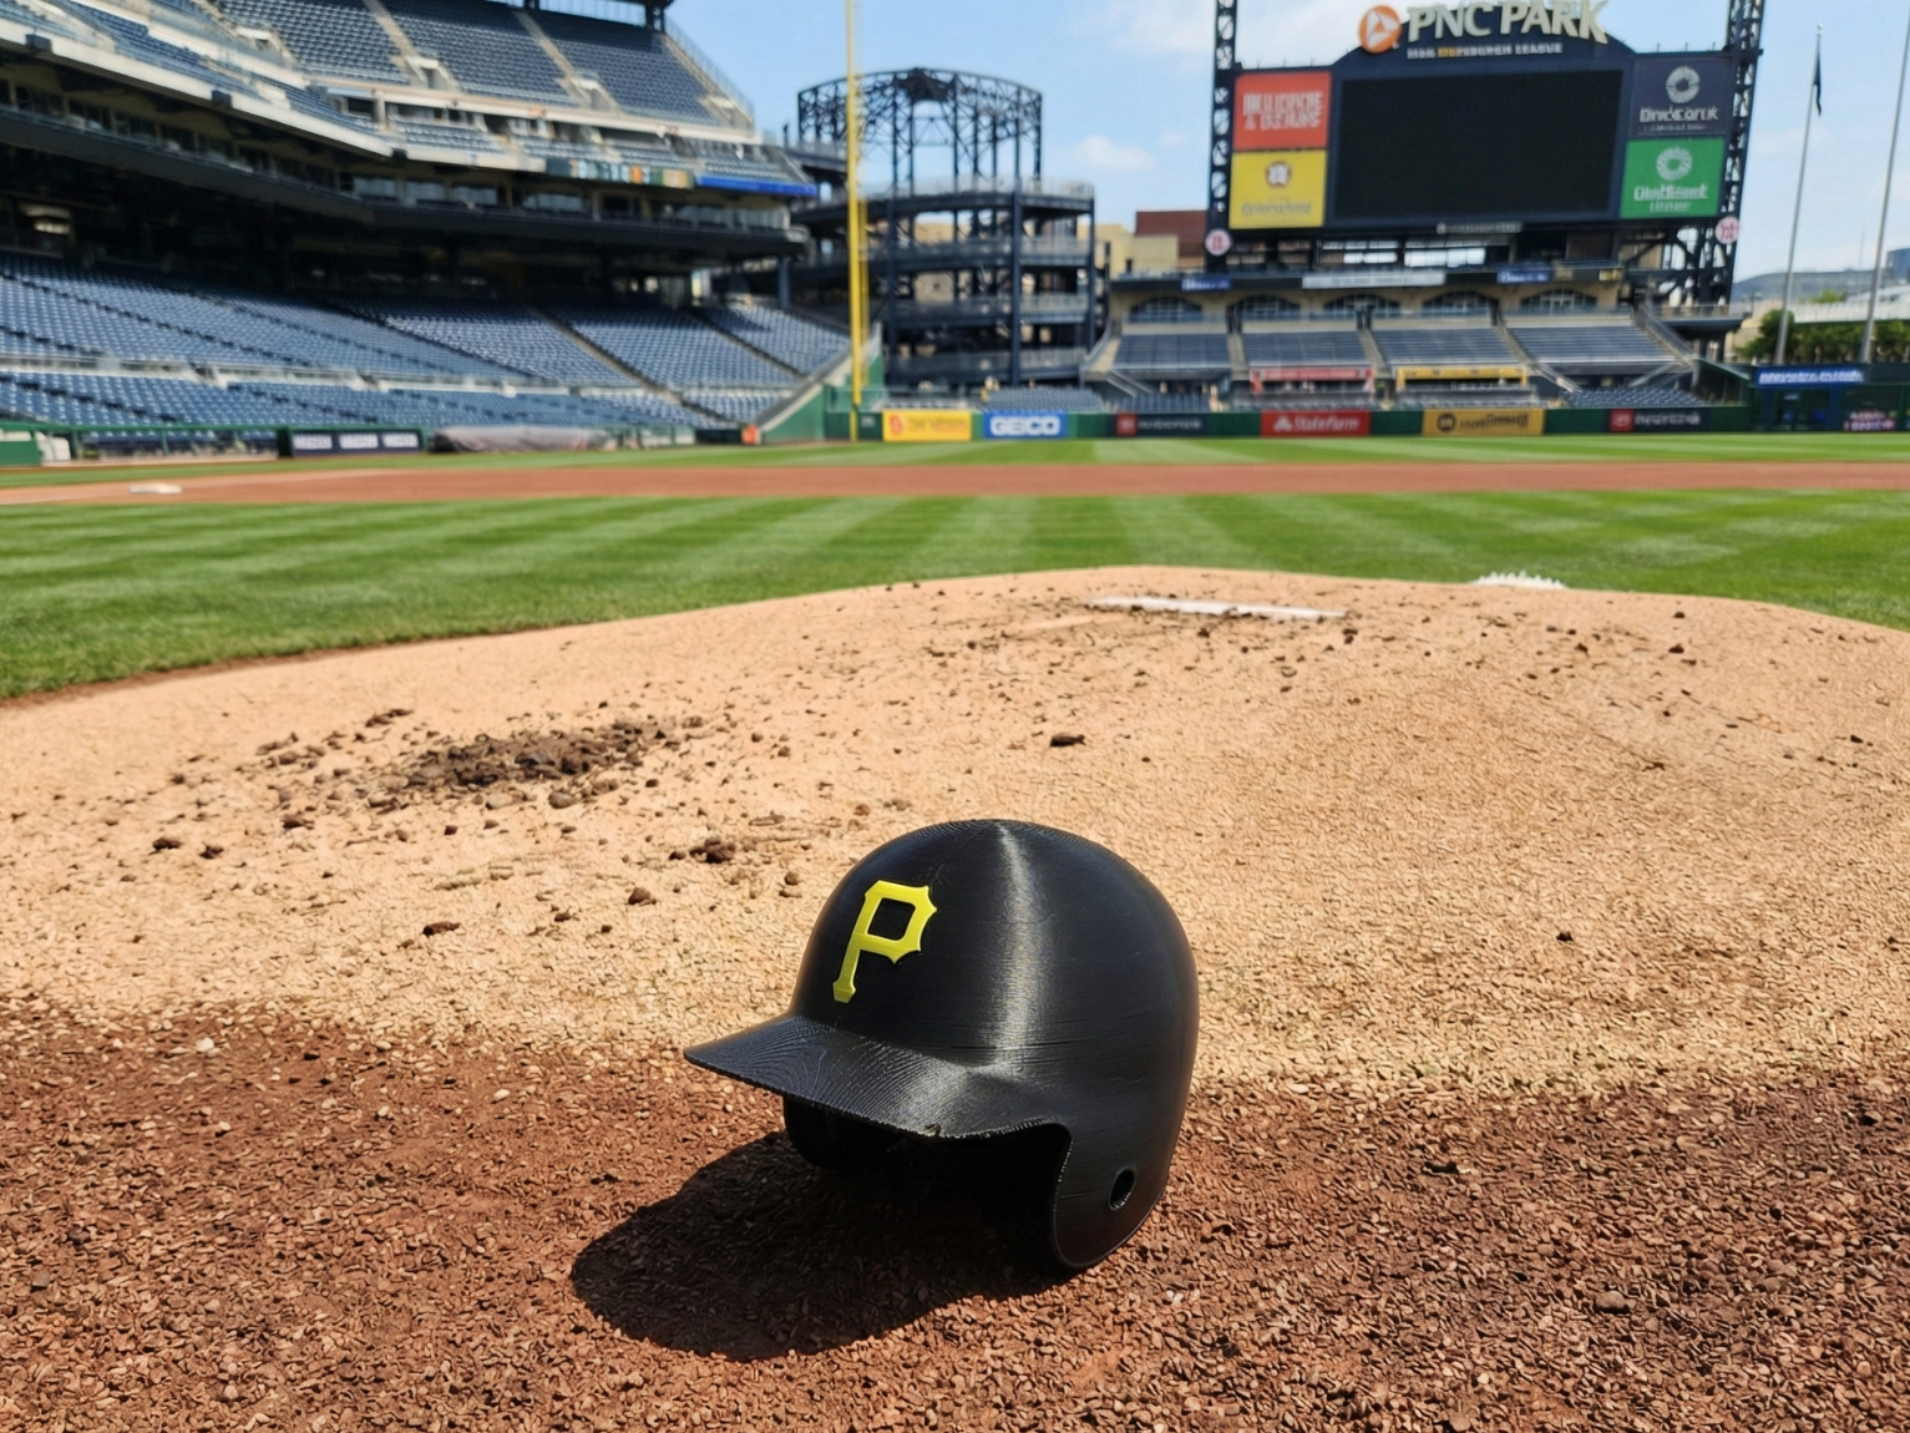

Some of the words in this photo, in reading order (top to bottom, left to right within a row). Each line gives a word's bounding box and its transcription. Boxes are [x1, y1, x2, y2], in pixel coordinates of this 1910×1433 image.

[1406, 3, 1495, 43] PNC
[1499, 0, 1609, 45] PARK
[989, 415, 1062, 436] GEICO
[833, 880, 938, 1004] P
